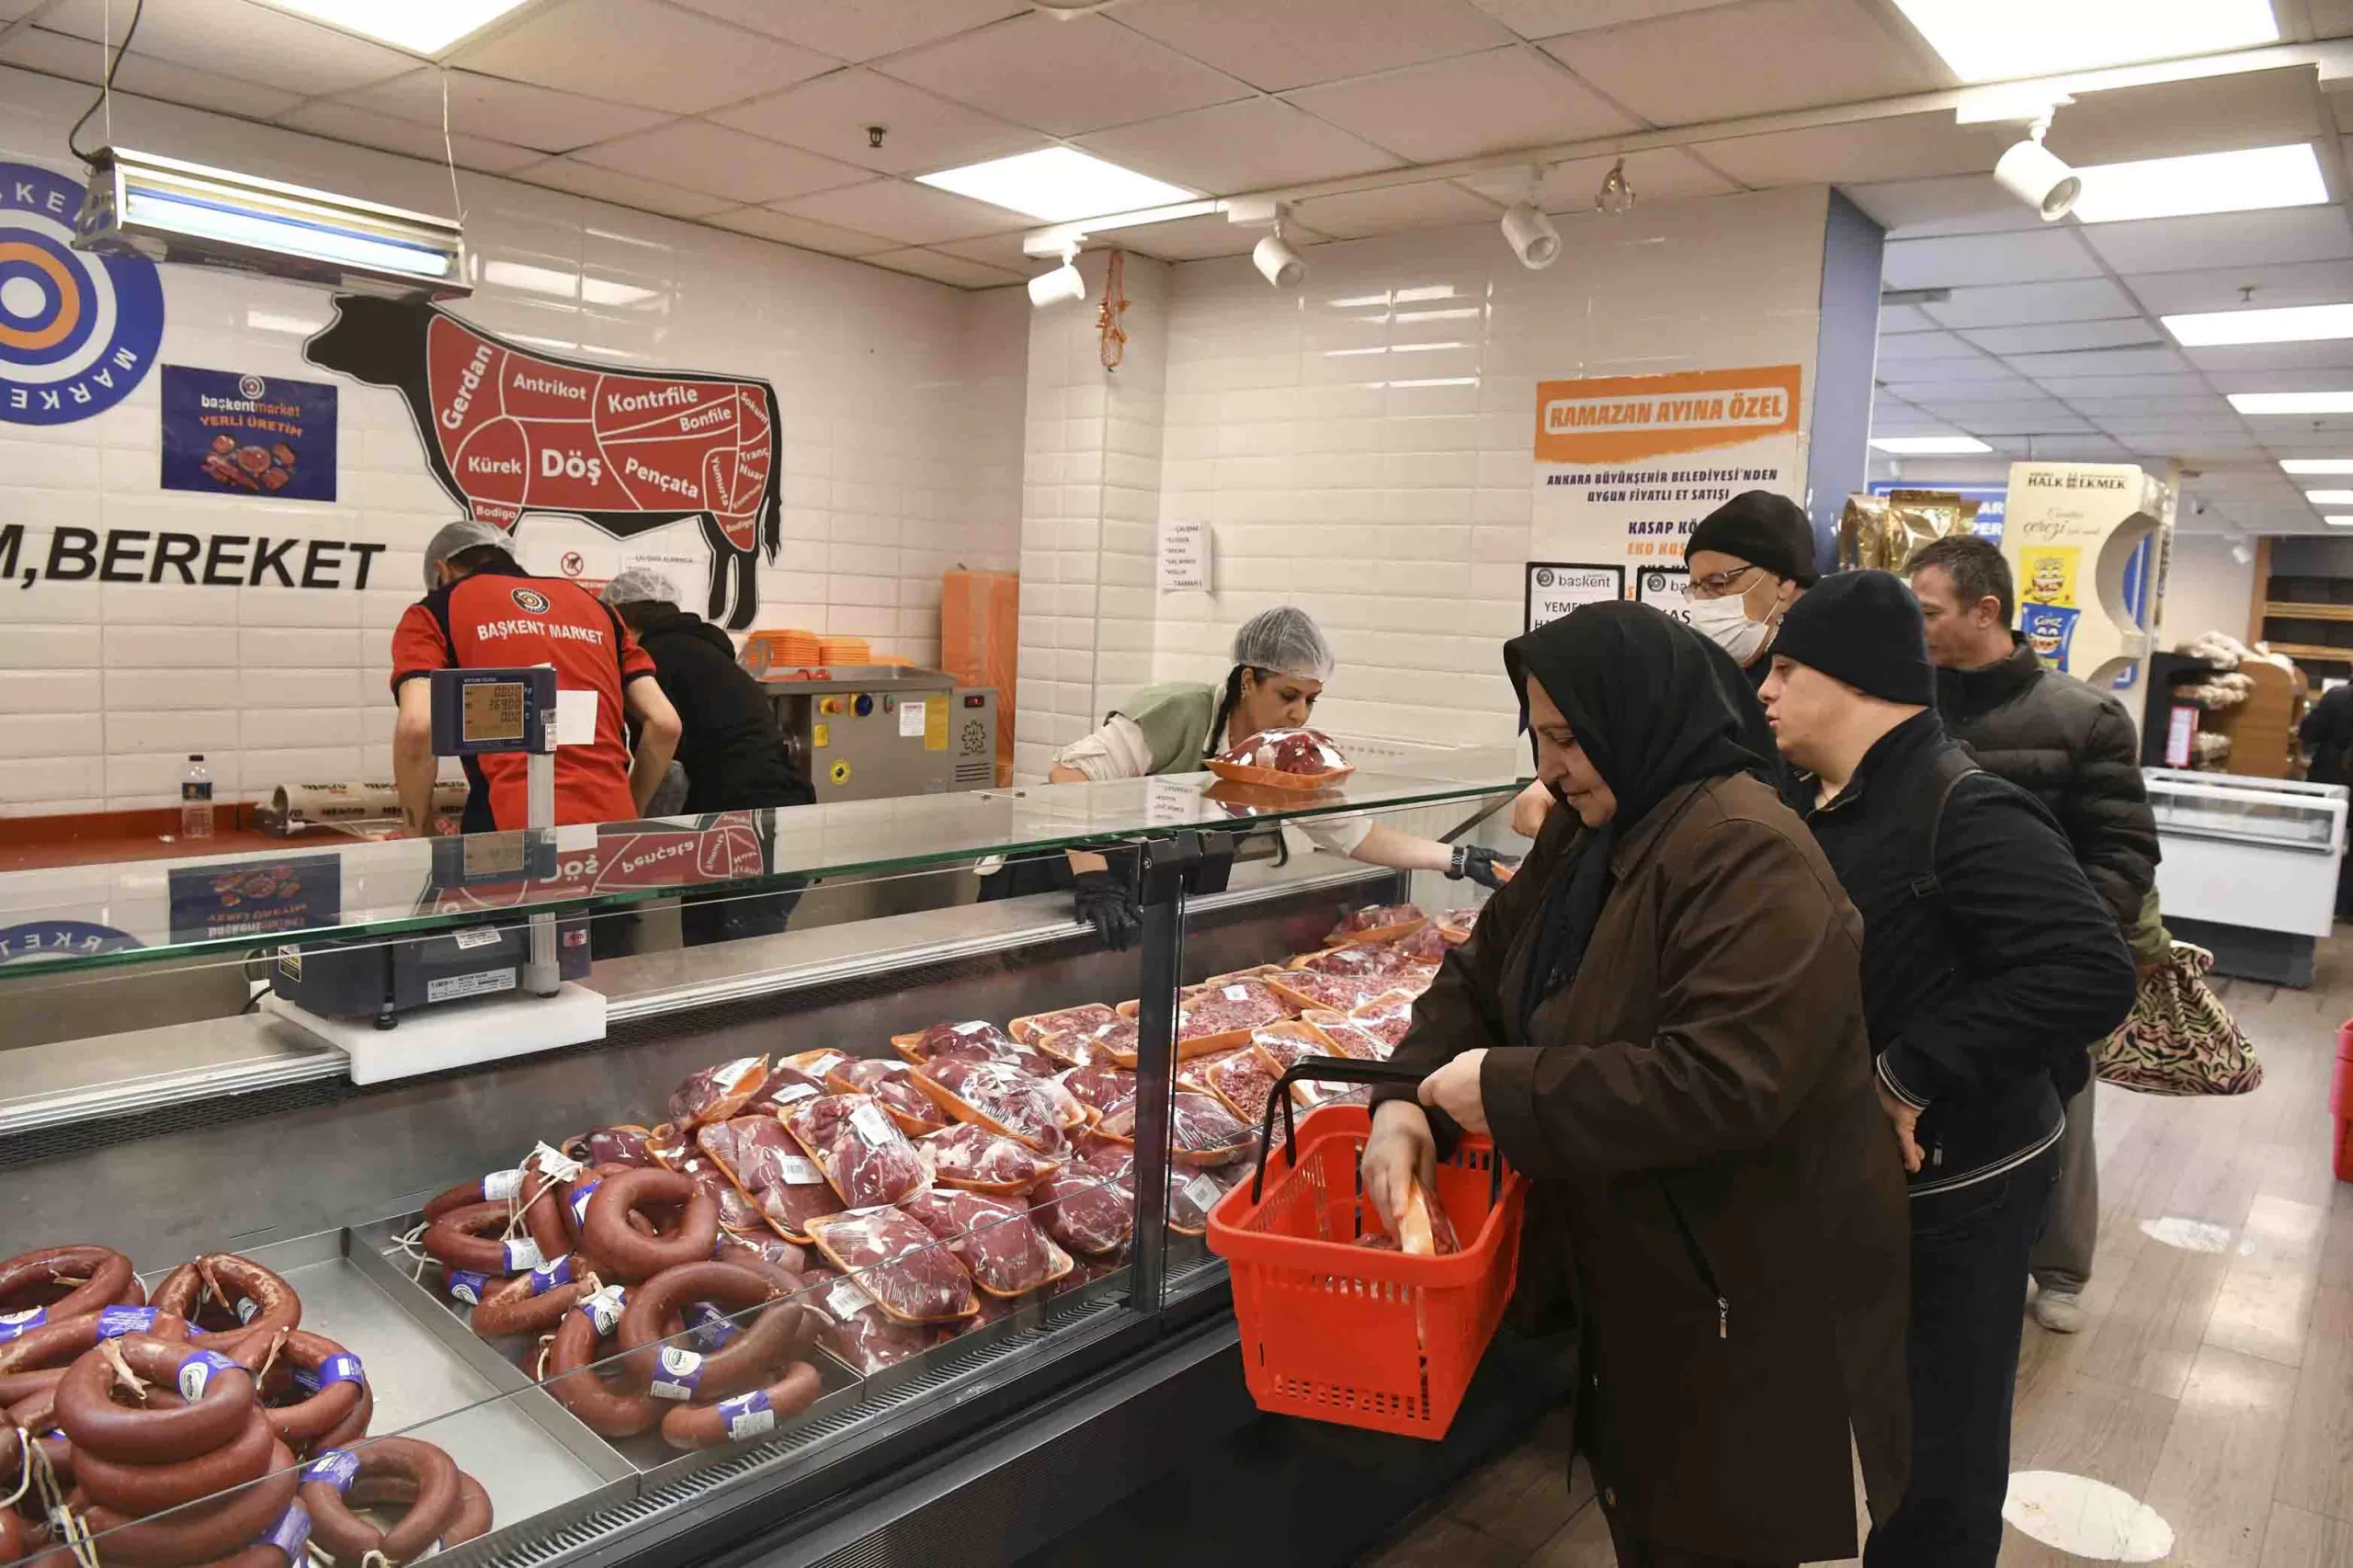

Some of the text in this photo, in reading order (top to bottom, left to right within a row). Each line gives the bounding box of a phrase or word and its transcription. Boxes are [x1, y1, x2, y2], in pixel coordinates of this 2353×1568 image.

[441, 344, 494, 431] Gerdan
[512, 371, 588, 402] Antrikot
[607, 384, 699, 415] Kontrfile
[679, 405, 733, 433] Bonfile
[739, 392, 769, 424] Sokum
[1550, 392, 1783, 428] RAMAZAN AYINA ÖZEL
[468, 455, 523, 476] Kürek
[540, 448, 603, 486] Döş
[624, 457, 699, 499] Pençata
[739, 463, 766, 482] Nuar
[1546, 473, 1591, 486] ANKARA
[1595, 470, 1667, 486] BÜYÜKŞEHİR
[1586, 487, 1730, 503] UYGUN FİYATLI ET SATIŞI
[2028, 476, 2126, 490] HALK EKMEK
[475, 505, 517, 521] Bodigo
[1628, 521, 1674, 535] KASAP
[1544, 601, 1584, 613] YEME
[476, 619, 604, 645] BAŞKENT MARKET
